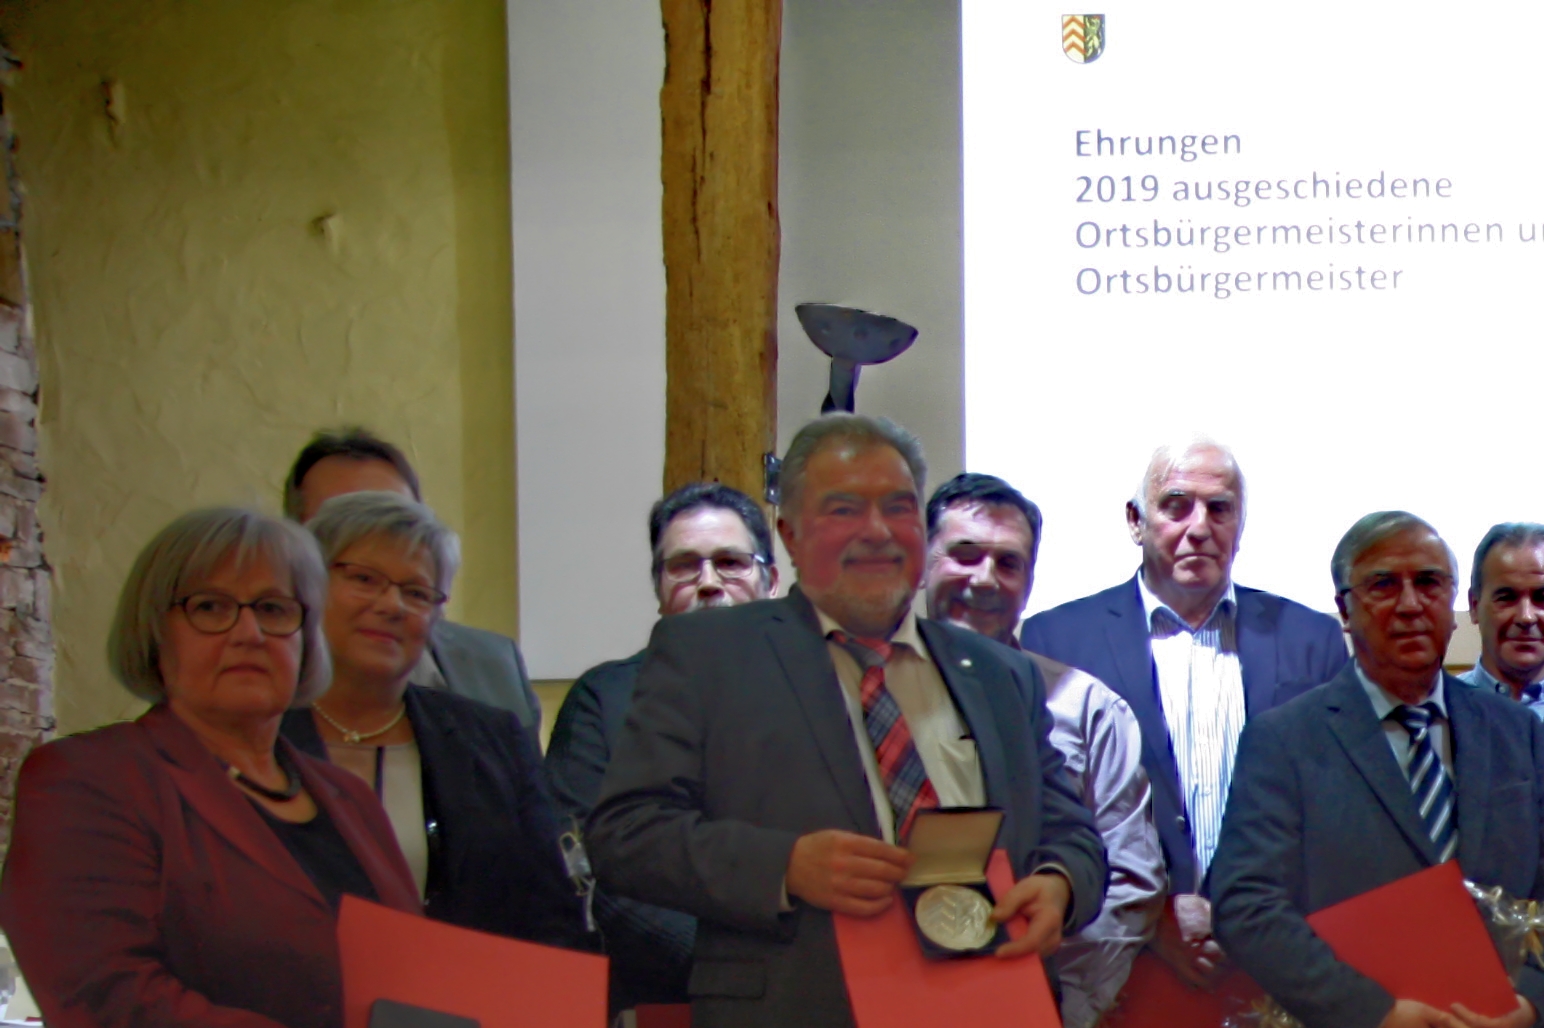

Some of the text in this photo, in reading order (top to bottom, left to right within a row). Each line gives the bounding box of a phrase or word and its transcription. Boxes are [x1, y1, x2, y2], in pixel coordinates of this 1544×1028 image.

[1074, 128, 1242, 162] Ehrungen
[1074, 170, 1454, 207] 2019 ausgeschiedene
[1074, 216, 1504, 253] Ortsbürgermeisterinnen
[1074, 263, 1405, 299] Ortsbürgermeister
